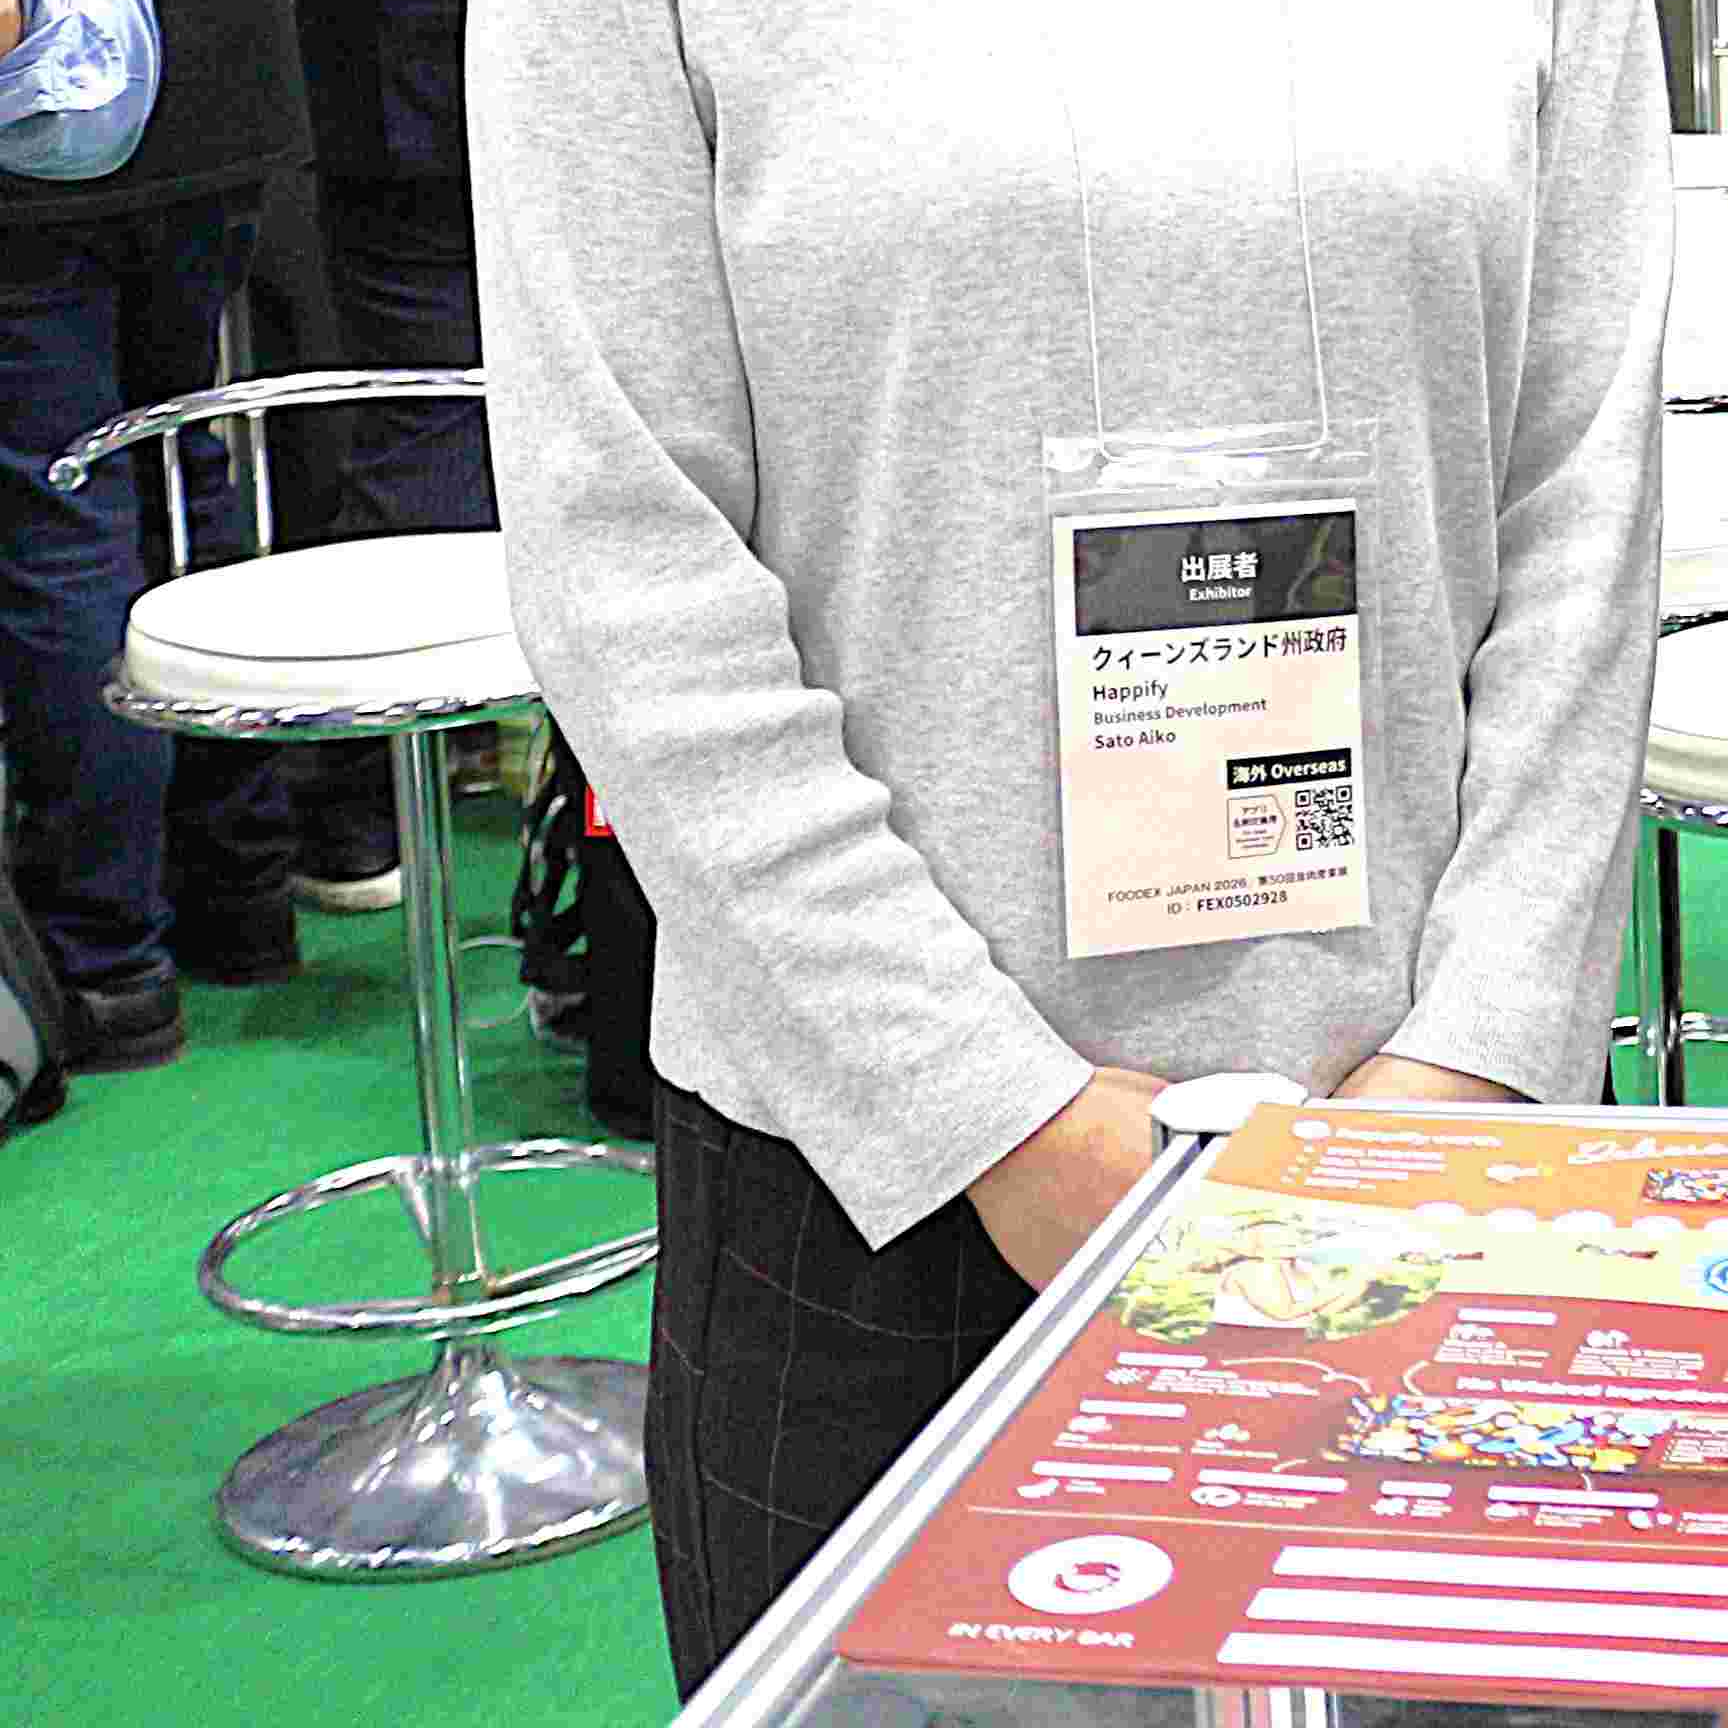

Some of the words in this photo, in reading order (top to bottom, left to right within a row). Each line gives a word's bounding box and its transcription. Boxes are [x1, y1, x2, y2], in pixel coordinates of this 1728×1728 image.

[1180, 552, 1259, 583] 出展者
[1189, 586, 1251, 602] Exhibitor
[1093, 679, 1168, 702] Happify
[1094, 707, 1160, 725] Business
[1165, 698, 1267, 720] Development
[1094, 734, 1134, 750] Sato
[1138, 730, 1176, 746] Aiko
[1232, 764, 1268, 785] 海外
[1271, 758, 1346, 780] Overseas
[1108, 886, 1160, 904] FOODEX
[1165, 881, 1211, 897] JAPAN
[1197, 890, 1288, 912] FEX0502928
